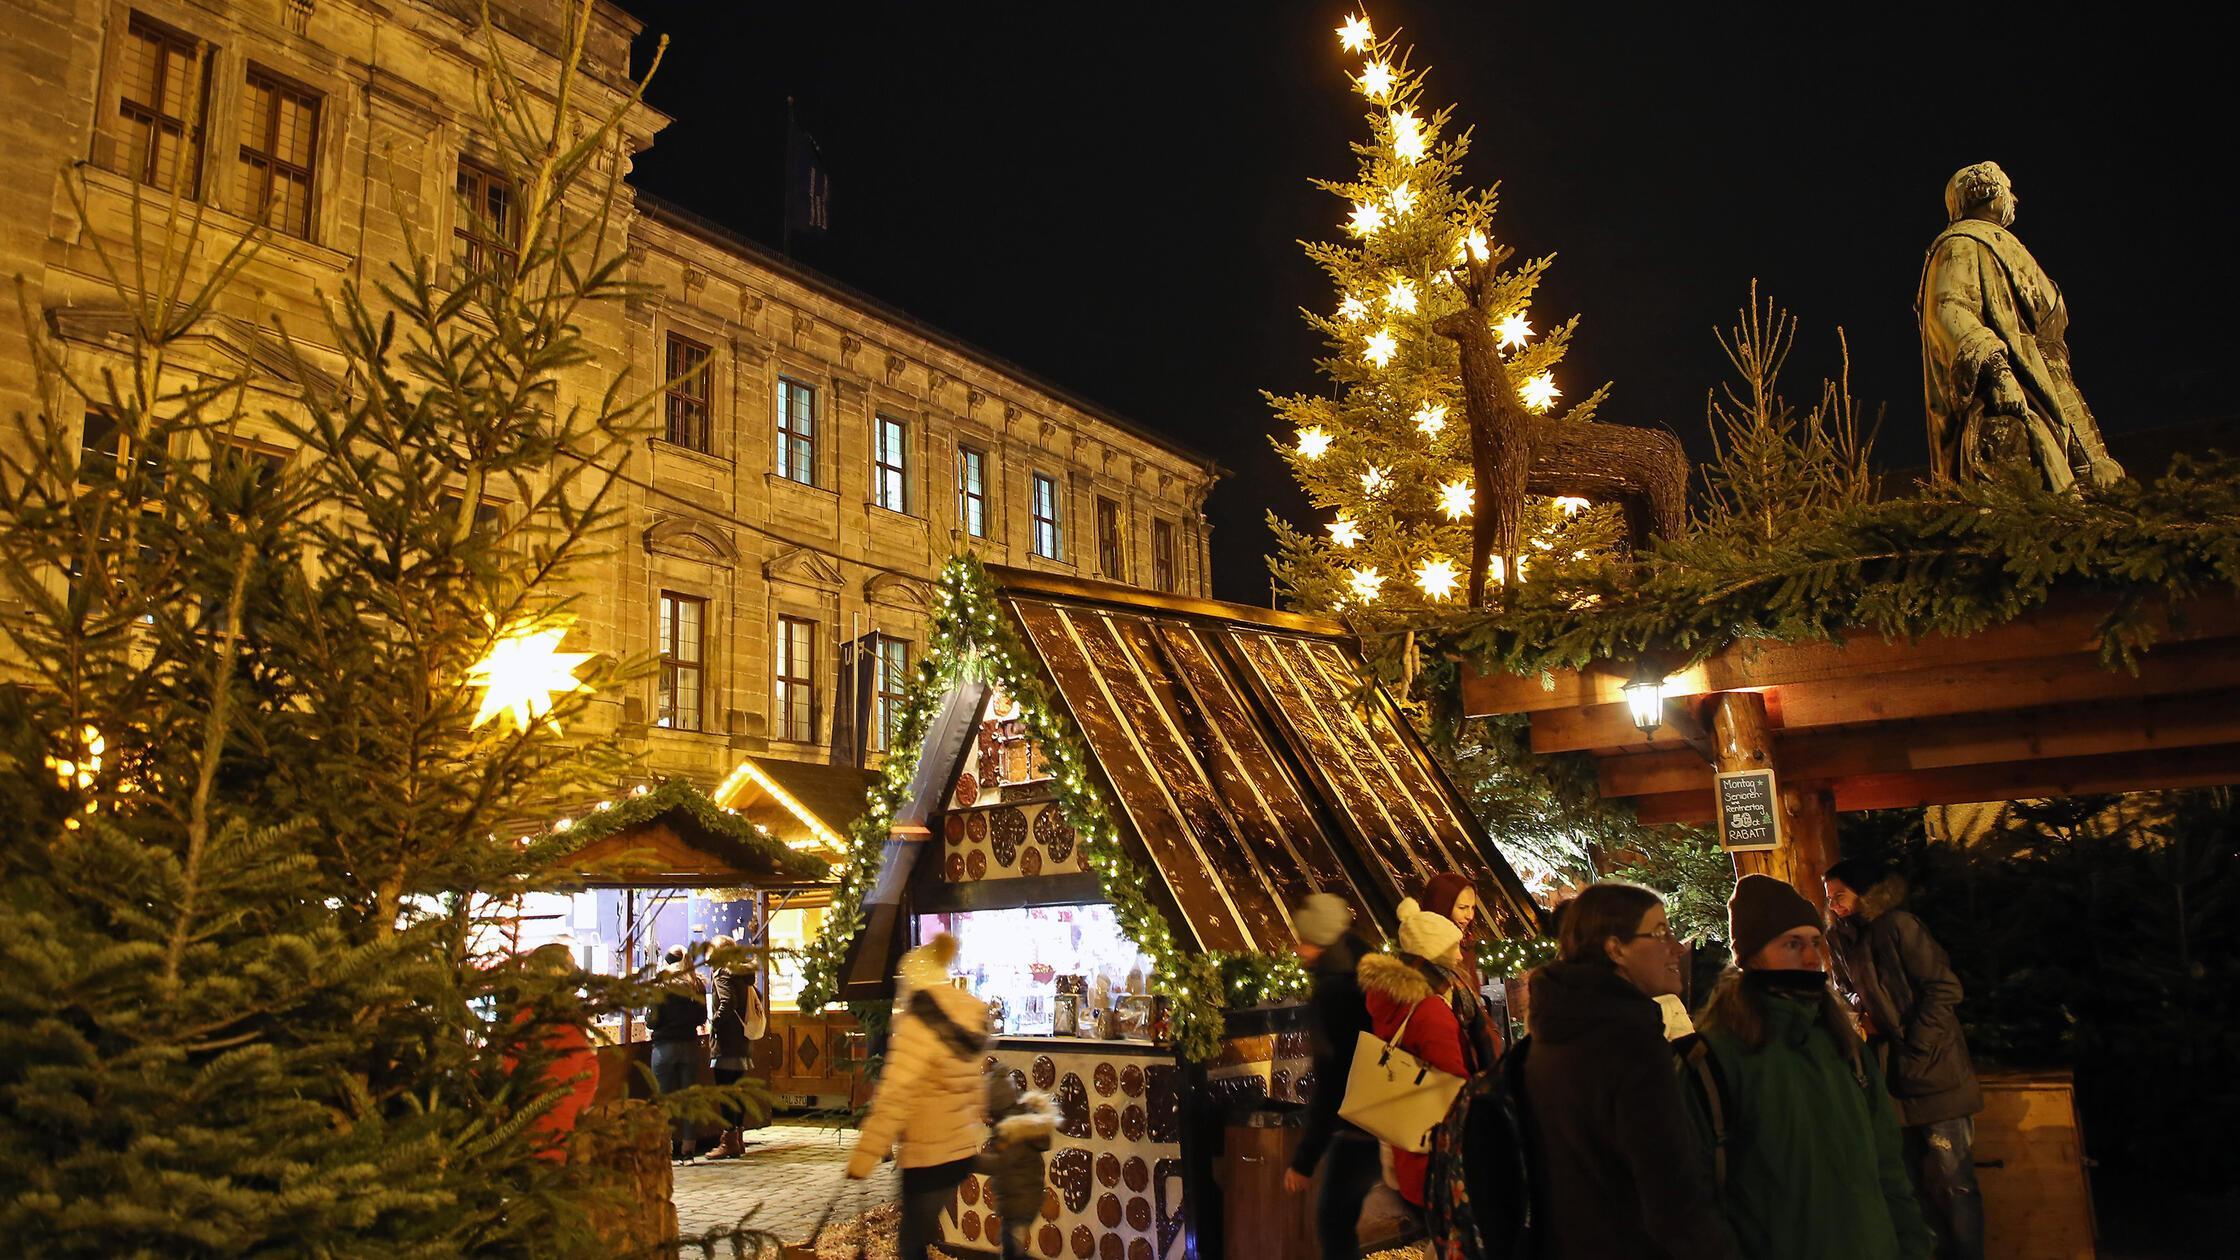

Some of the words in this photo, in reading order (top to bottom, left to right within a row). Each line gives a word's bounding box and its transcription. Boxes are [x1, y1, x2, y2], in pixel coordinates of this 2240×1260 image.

[1723, 779, 1756, 793] Montag
[1725, 803, 1765, 815] Rentnertag
[1729, 828, 1766, 840] RABATT
